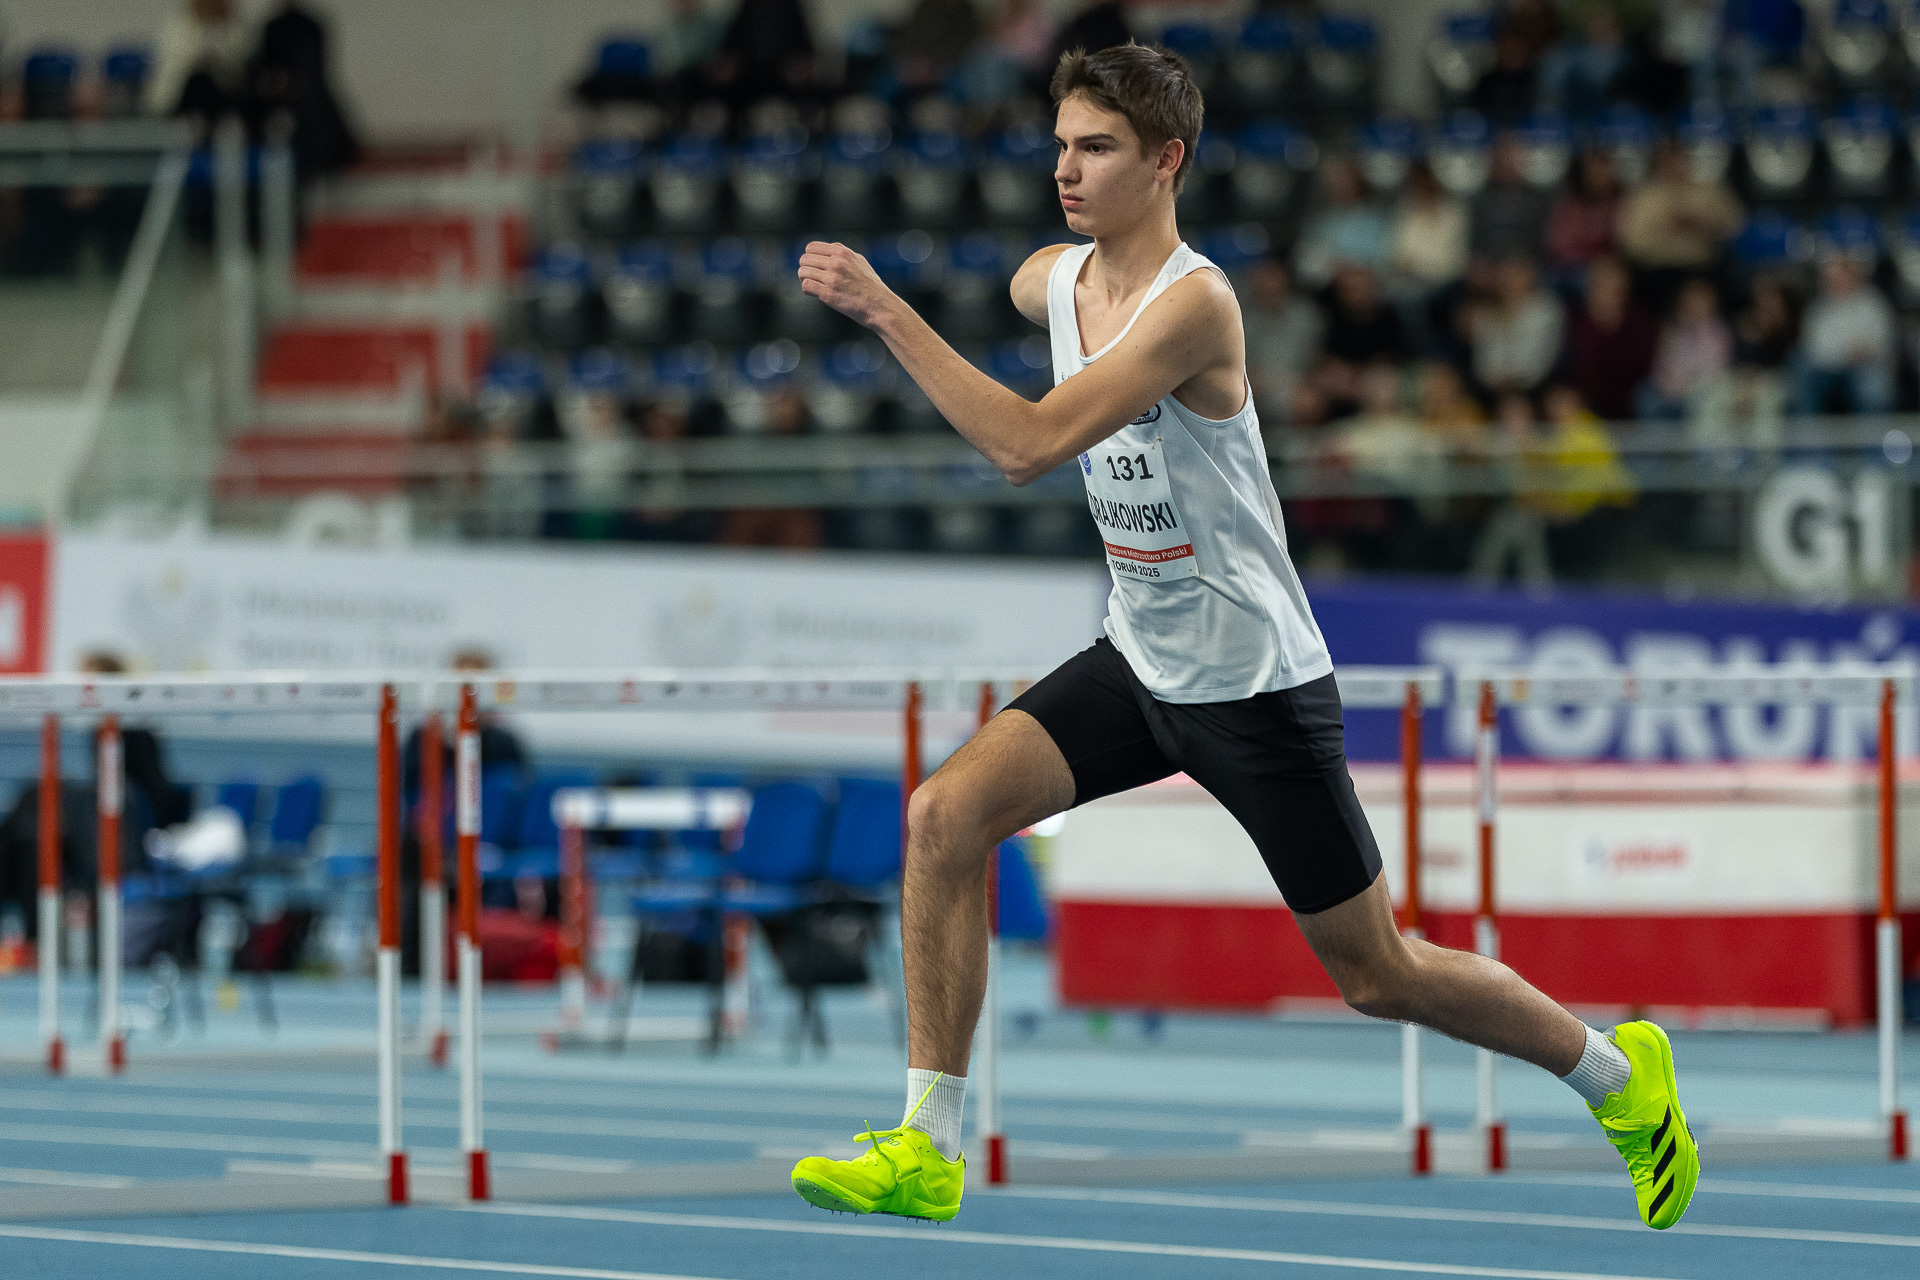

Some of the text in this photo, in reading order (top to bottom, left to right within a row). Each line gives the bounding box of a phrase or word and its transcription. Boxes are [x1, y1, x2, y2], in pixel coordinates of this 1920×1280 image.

[1106, 453, 1154, 481] 131
[1161, 546, 1188, 560] Polski
[1111, 559, 1160, 577] TORUŃ 2025
